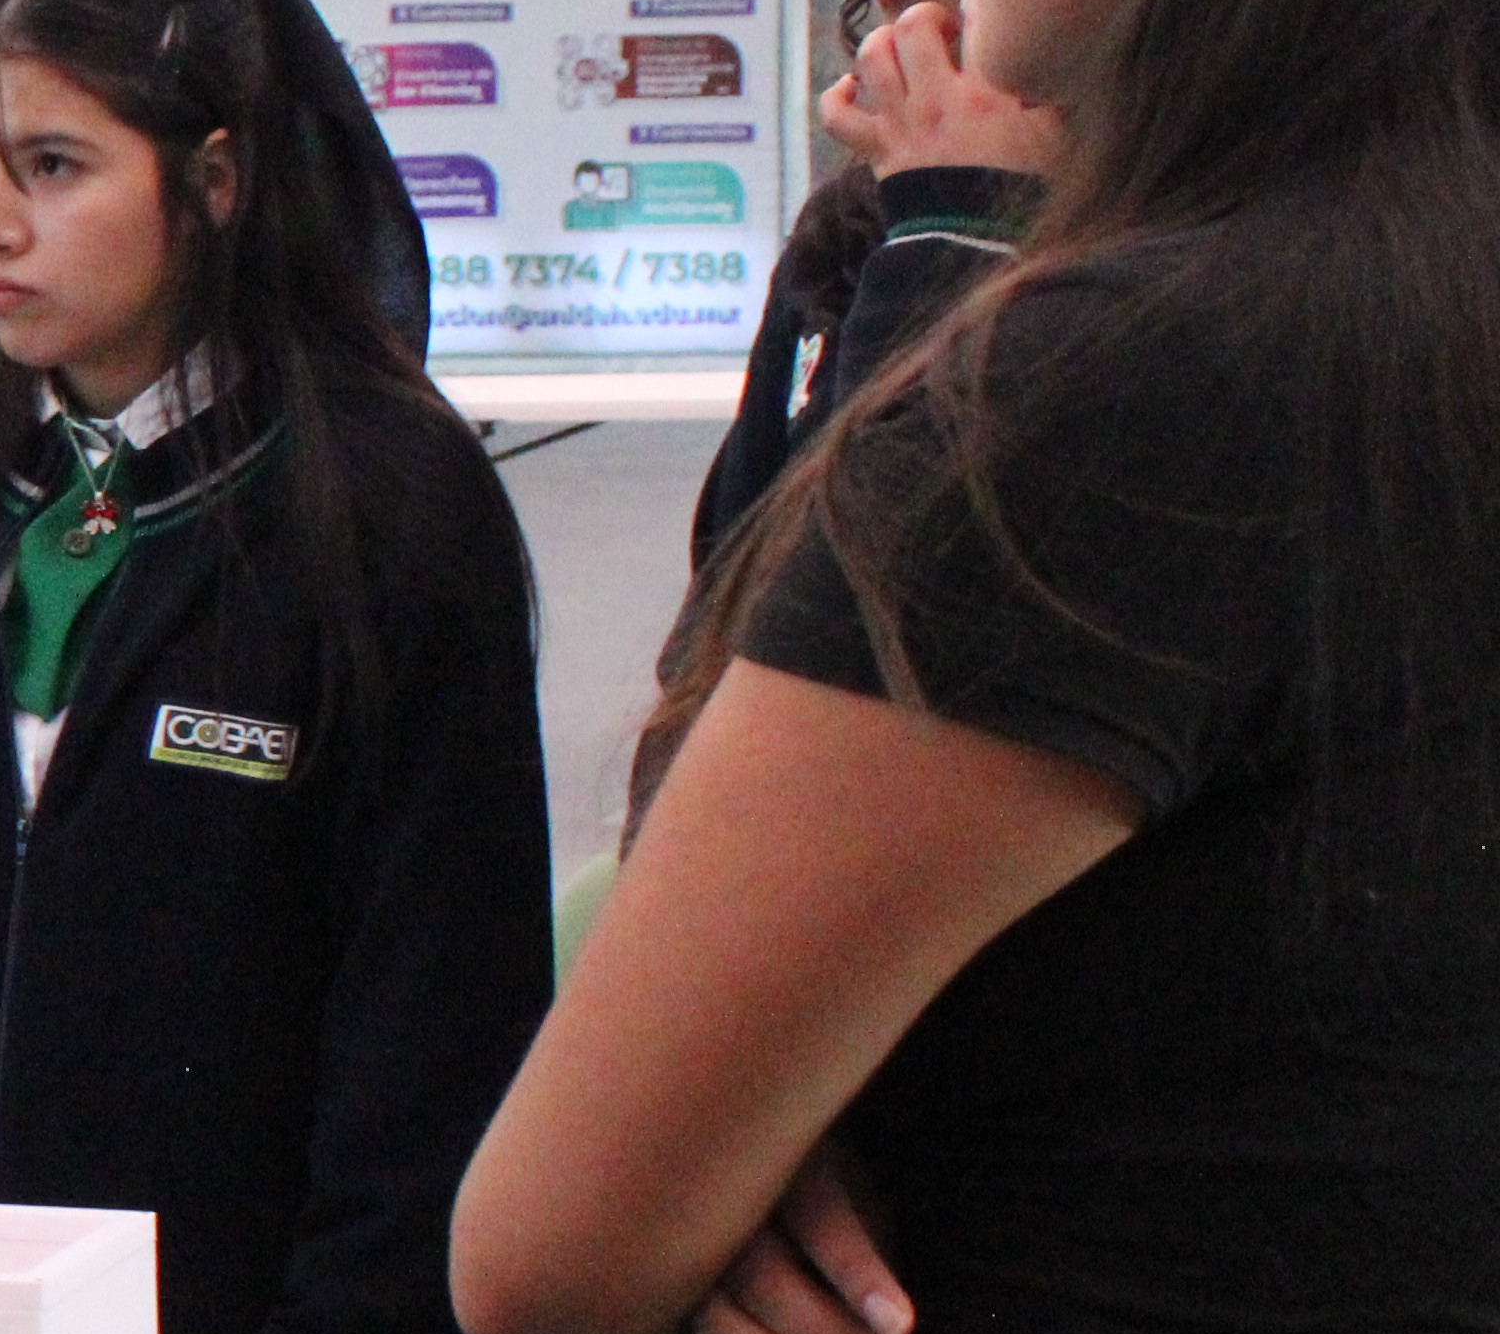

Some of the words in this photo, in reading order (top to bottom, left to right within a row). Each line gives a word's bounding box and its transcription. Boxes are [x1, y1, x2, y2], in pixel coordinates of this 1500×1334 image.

[431, 254, 491, 285] 88
[504, 253, 600, 285] 7374
[642, 251, 747, 284] 7388
